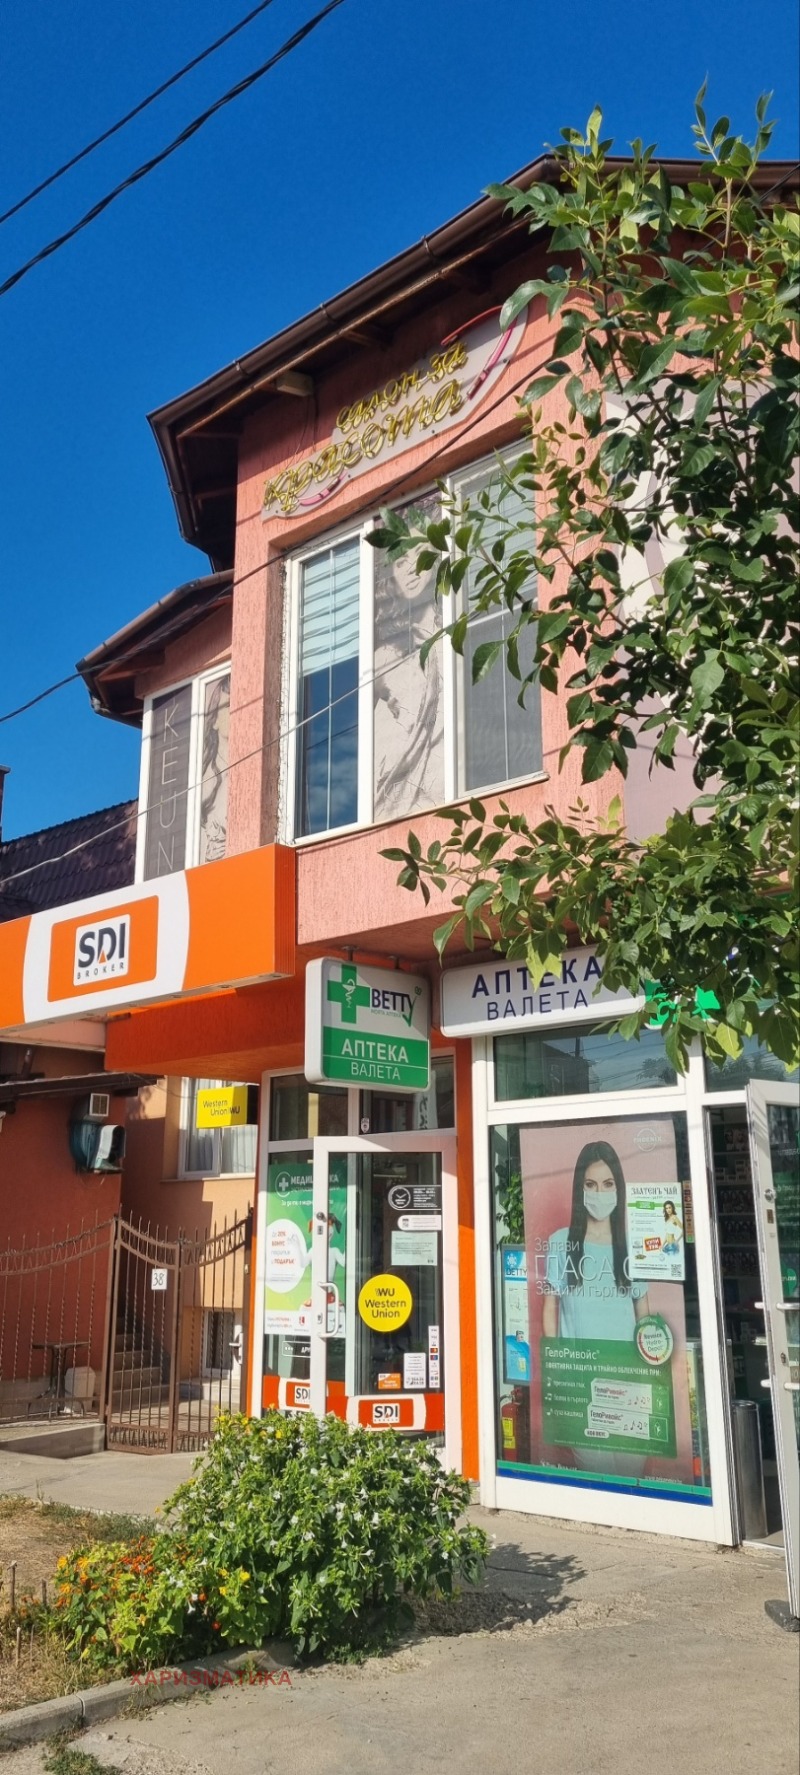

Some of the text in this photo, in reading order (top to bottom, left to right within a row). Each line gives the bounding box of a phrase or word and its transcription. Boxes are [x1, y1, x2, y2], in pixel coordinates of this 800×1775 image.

[78, 922, 126, 969] SDI
[77, 962, 124, 980] BROKER
[371, 988, 415, 1018] BETTY
[487, 989, 588, 1021] ВАЛЕТА
[341, 1038, 409, 1063] АПТЕКА
[351, 1061, 401, 1080] ВАЛЕТА
[203, 1100, 228, 1108] Western
[210, 1108, 228, 1116] Union
[535, 1255, 616, 1281] ГЛАСА
[152, 1272, 165, 1286] 38
[364, 1299, 407, 1308] Western
[371, 1309, 400, 1318] Union
[374, 1405, 398, 1418] SDI
